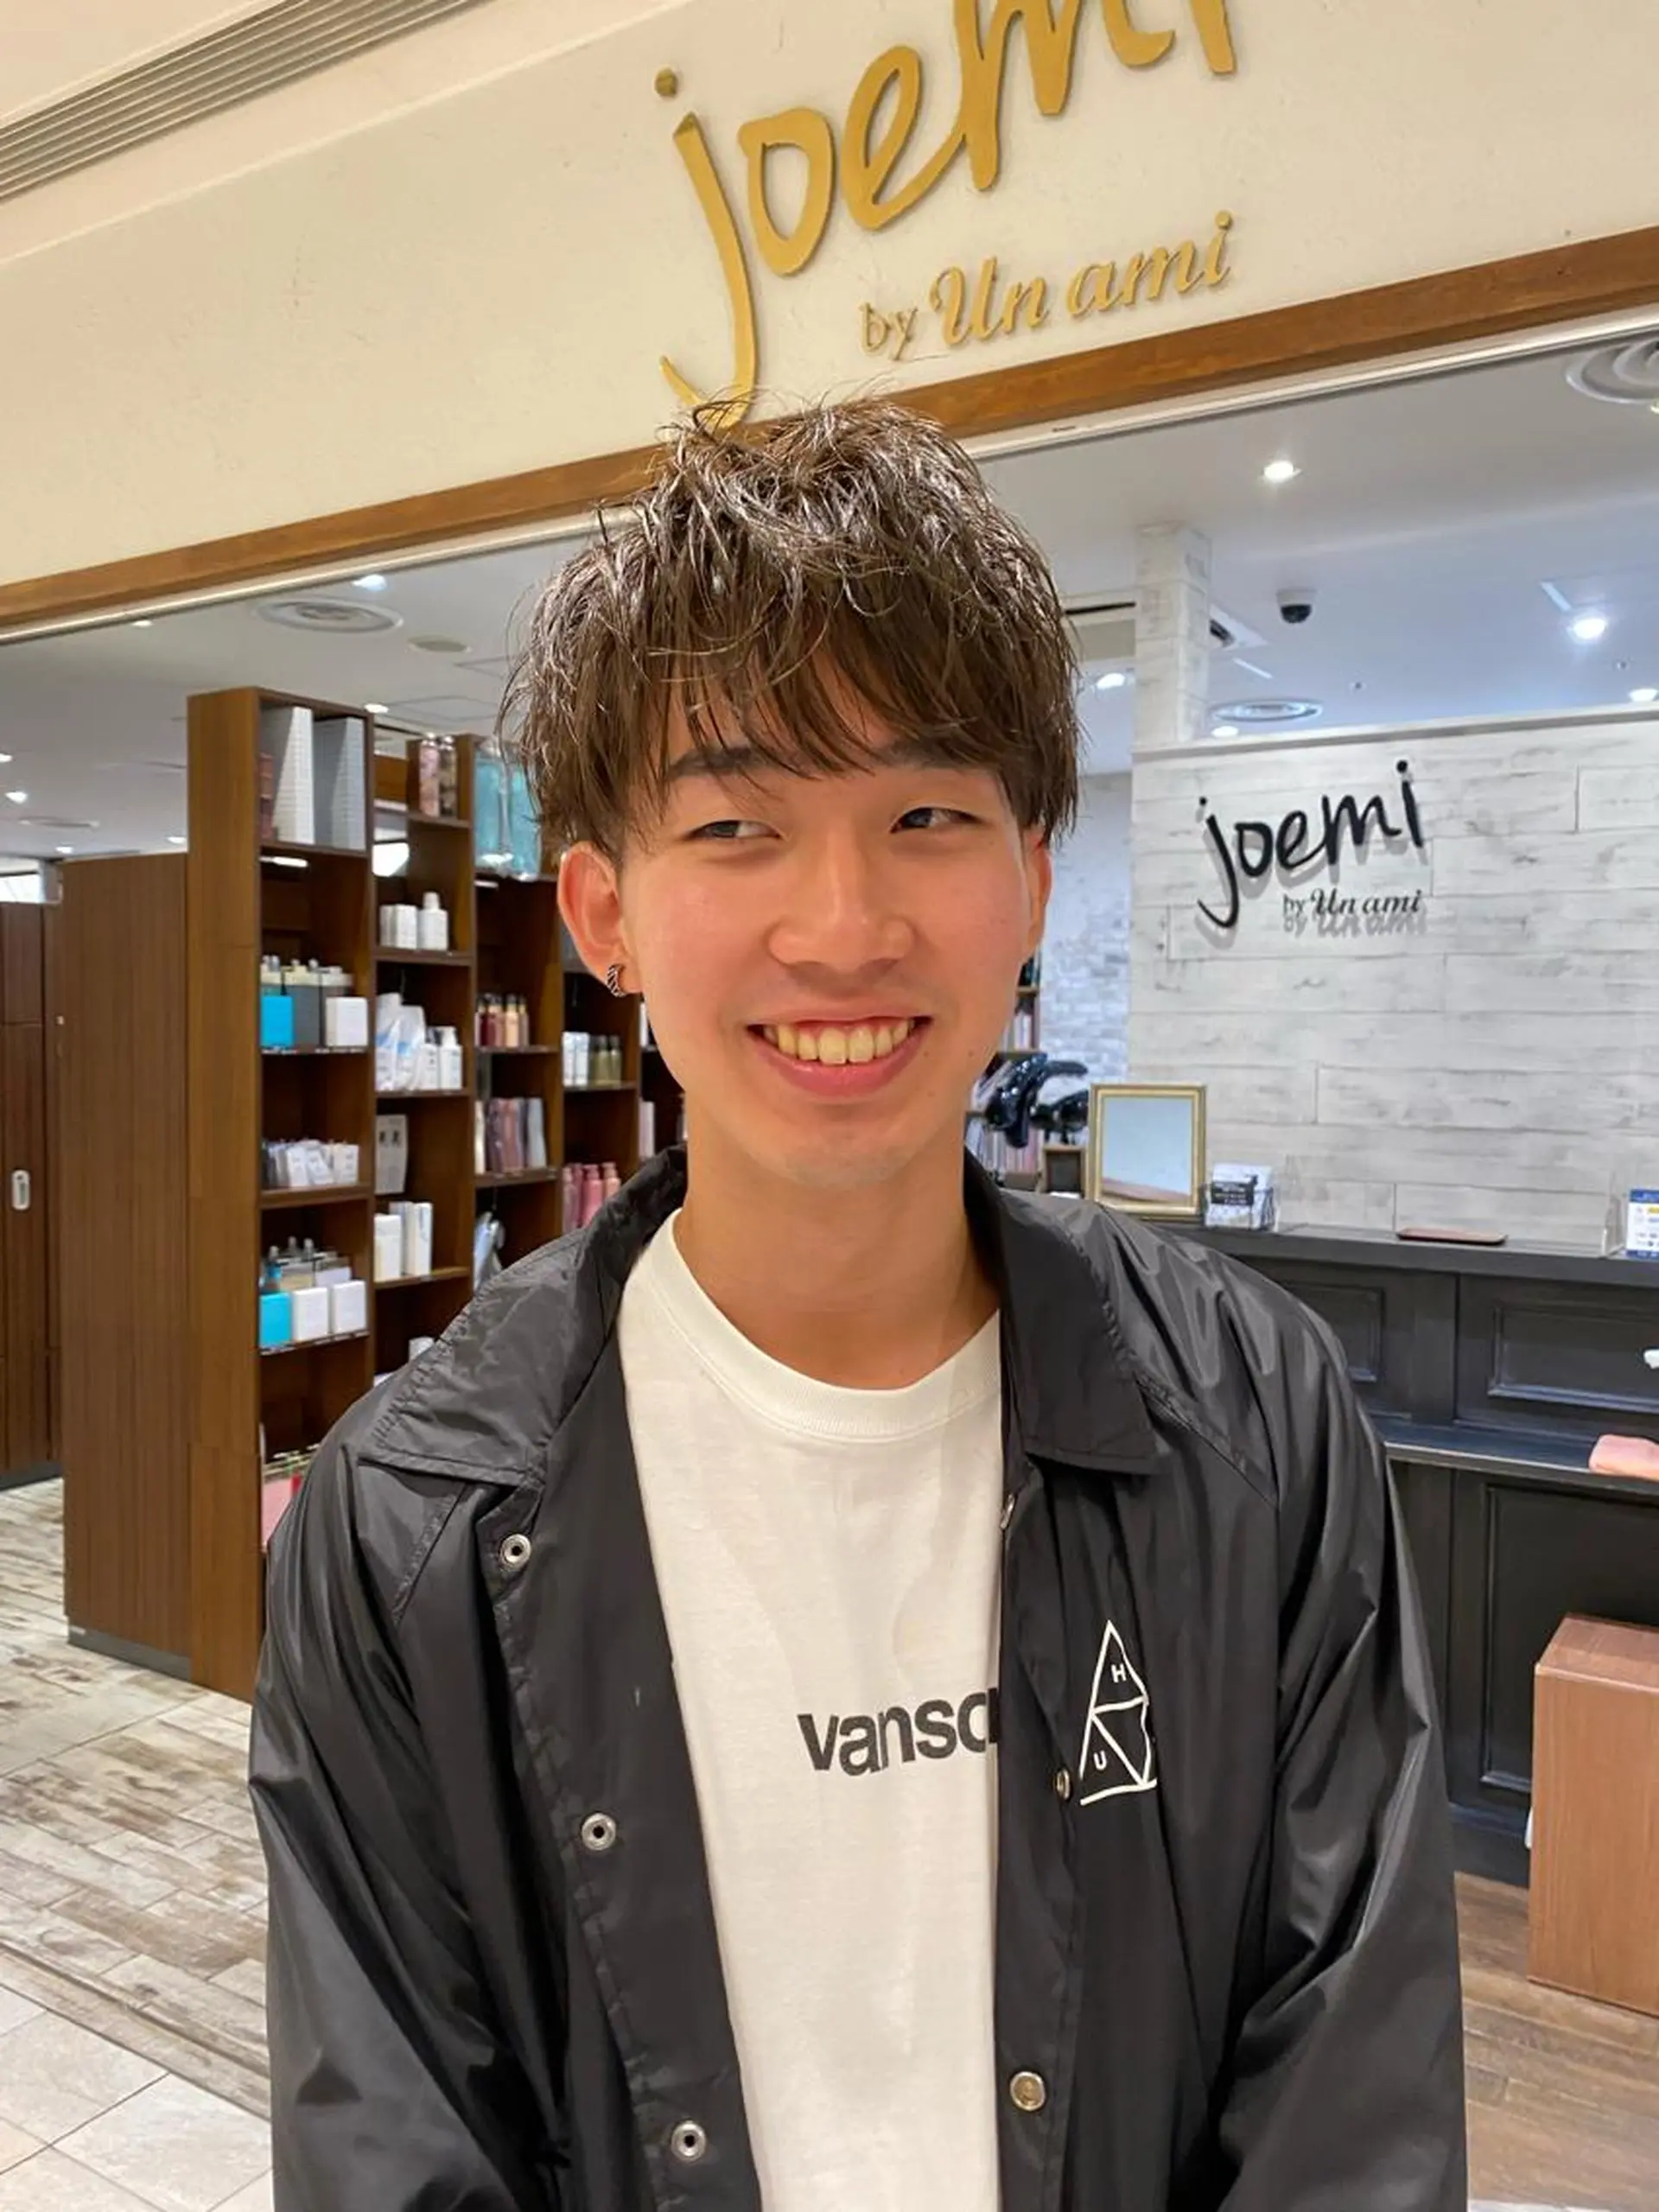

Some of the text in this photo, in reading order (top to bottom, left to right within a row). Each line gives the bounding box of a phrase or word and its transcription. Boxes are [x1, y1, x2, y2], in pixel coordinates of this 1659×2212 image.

[861, 210, 1233, 361] by Un ami
[1198, 760, 1424, 928] joemi
[1282, 887, 1422, 918] by Un ami
[797, 1687, 999, 1776] vanso
